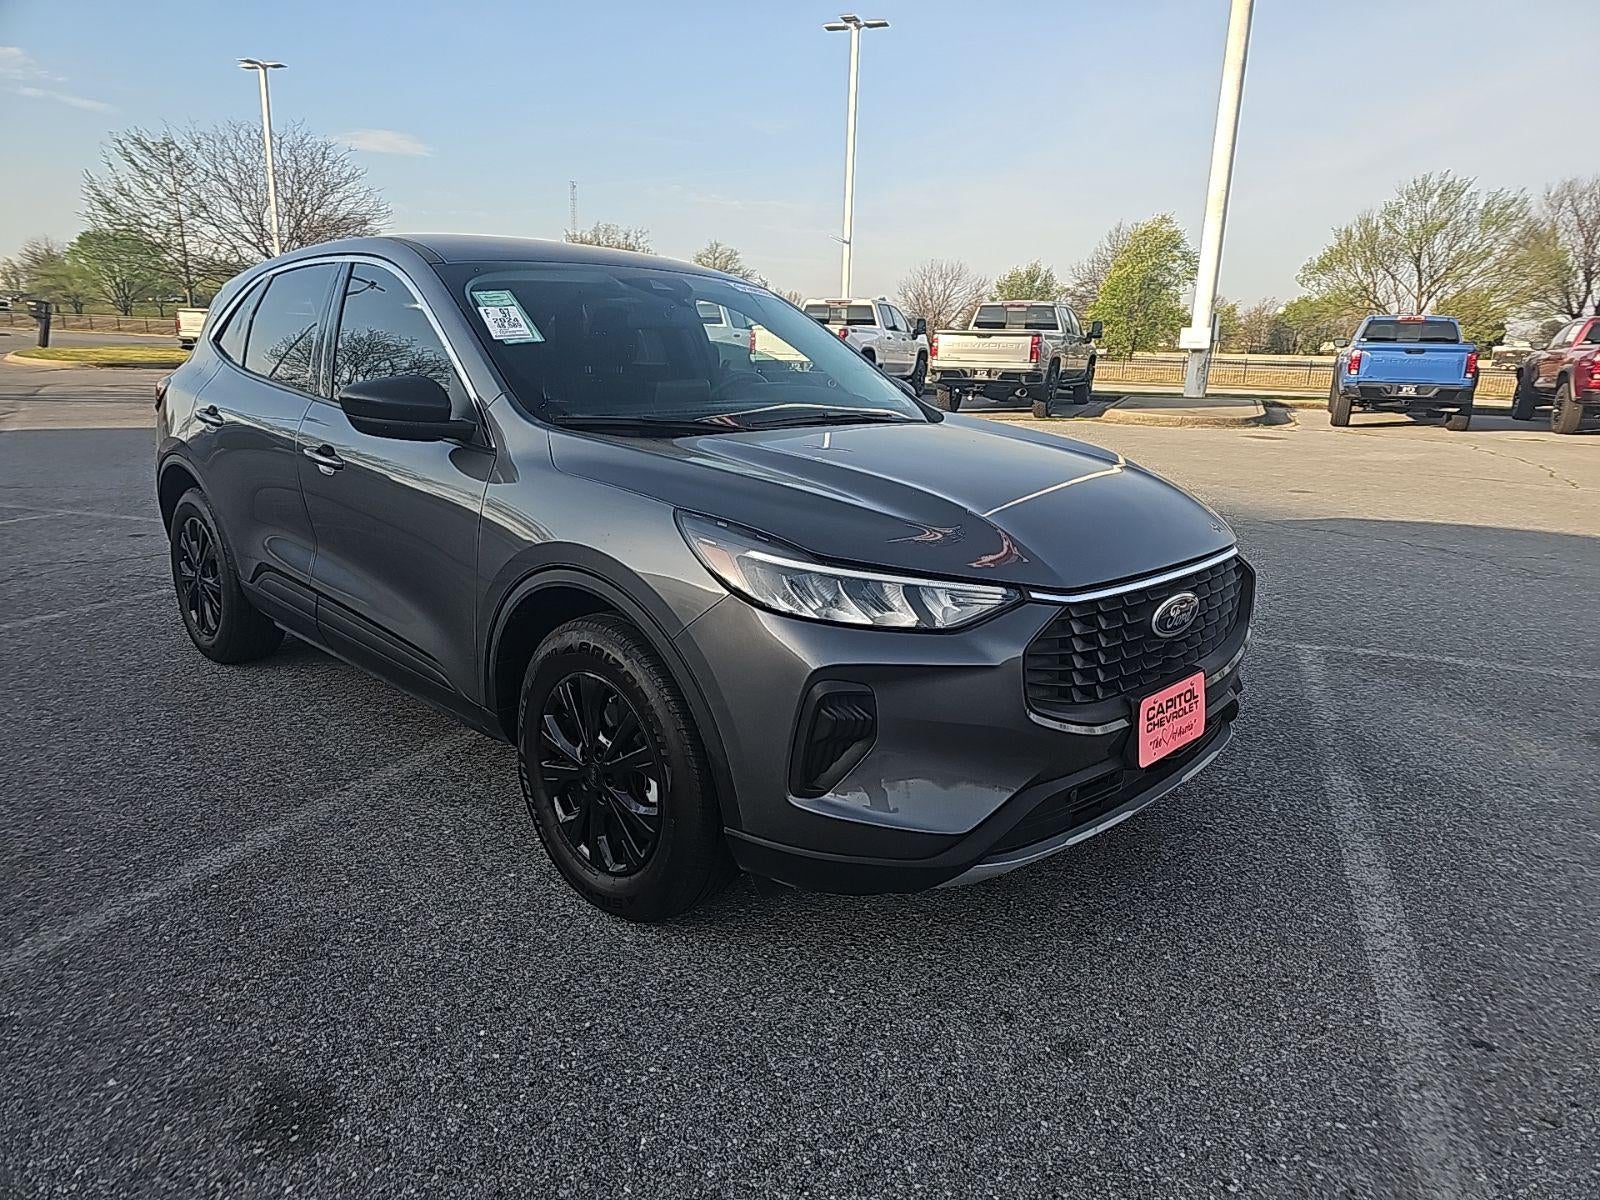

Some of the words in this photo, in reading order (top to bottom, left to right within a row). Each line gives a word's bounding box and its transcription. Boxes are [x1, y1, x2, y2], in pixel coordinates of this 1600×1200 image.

[483, 308, 491, 319] F
[498, 307, 512, 318] 97
[1166, 602, 1193, 629] Ford
[1146, 686, 1199, 722] CAPITOL
[1146, 700, 1199, 734] CHEVROLET
